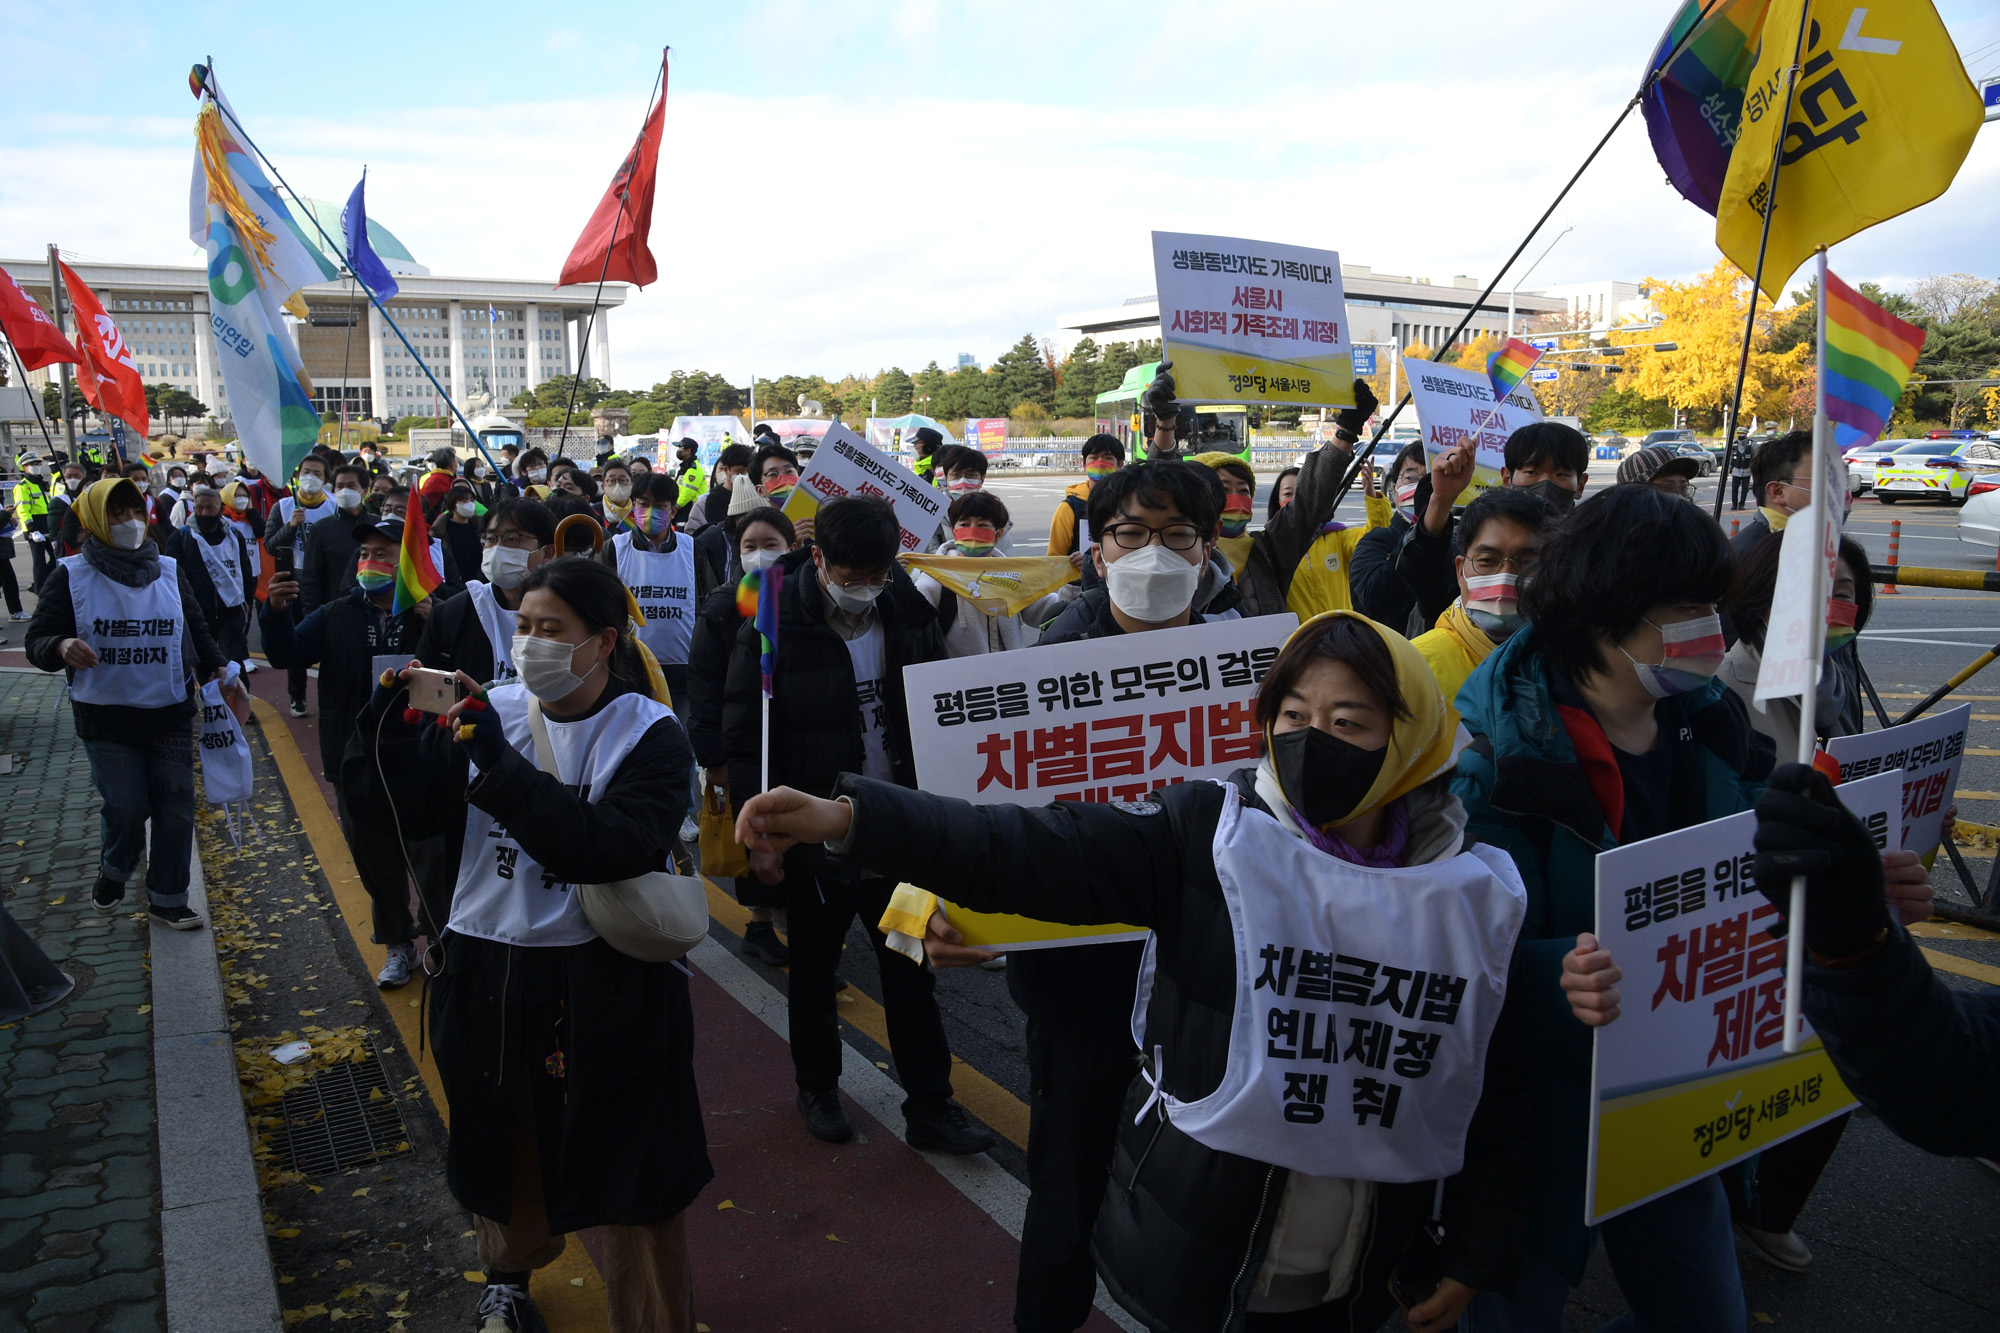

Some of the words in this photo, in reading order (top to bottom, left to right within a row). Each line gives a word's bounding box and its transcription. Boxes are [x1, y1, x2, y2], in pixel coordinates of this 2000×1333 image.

[1172, 250, 1268, 276] 생활동반자도
[1271, 259, 1333, 285] 가족이다!
[1232, 285, 1283, 312] 서울시
[211, 313, 256, 358] 민연합
[1171, 310, 1227, 335] 사회적
[1231, 313, 1299, 340] 가족조례
[1302, 320, 1339, 345] 제정!
[1228, 374, 1268, 394] 정의당
[1269, 377, 1311, 393] 서울시당
[1421, 375, 1491, 402] 생활동반자도
[1469, 408, 1507, 432] 서울시
[833, 439, 898, 488] 생활동반자도
[895, 479, 940, 516] 가족이다!
[629, 585, 687, 600] 차별금지법
[92, 618, 175, 638] 차별금지법
[99, 646, 169, 666] 제정하자
[932, 681, 1031, 727] 평등을
[1037, 670, 1104, 712] 위한
[1110, 656, 1211, 702] 모두의
[976, 698, 1264, 793] 차별금지법
[1907, 737, 1945, 772] 모두의
[1943, 730, 1964, 761] 걸음
[1624, 867, 1706, 932] 평등을
[1254, 943, 1468, 1025] 차별금지법
[1267, 1007, 1339, 1064] 연내
[1343, 1018, 1442, 1079] 제정
[1282, 1072, 1329, 1124] 쟁
[1352, 1076, 1402, 1129] 취
[1693, 1103, 1755, 1158] 정의당
[1756, 1073, 1824, 1123] 서울시당
